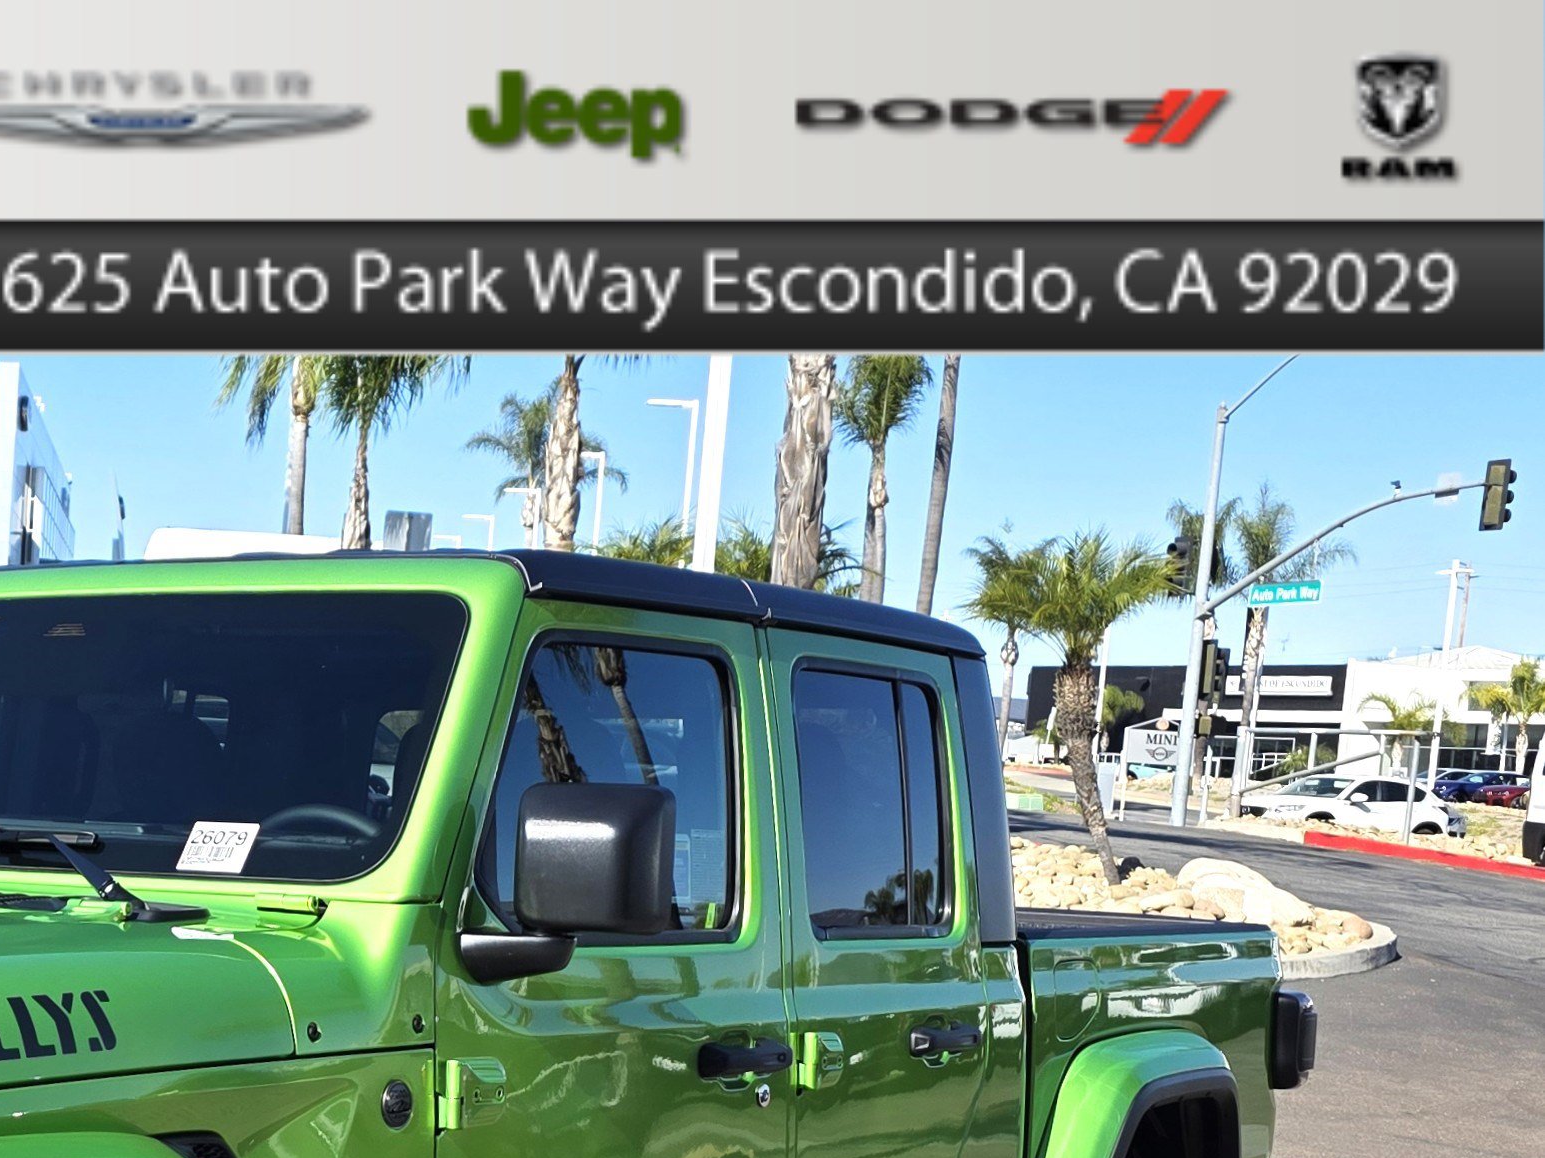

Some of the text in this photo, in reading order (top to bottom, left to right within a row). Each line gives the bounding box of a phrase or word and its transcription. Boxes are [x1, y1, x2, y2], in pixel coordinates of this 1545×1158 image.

[1252, 586, 1320, 602] Auto Park Way
[1145, 733, 1178, 746] MINI
[190, 829, 249, 846] 26079
